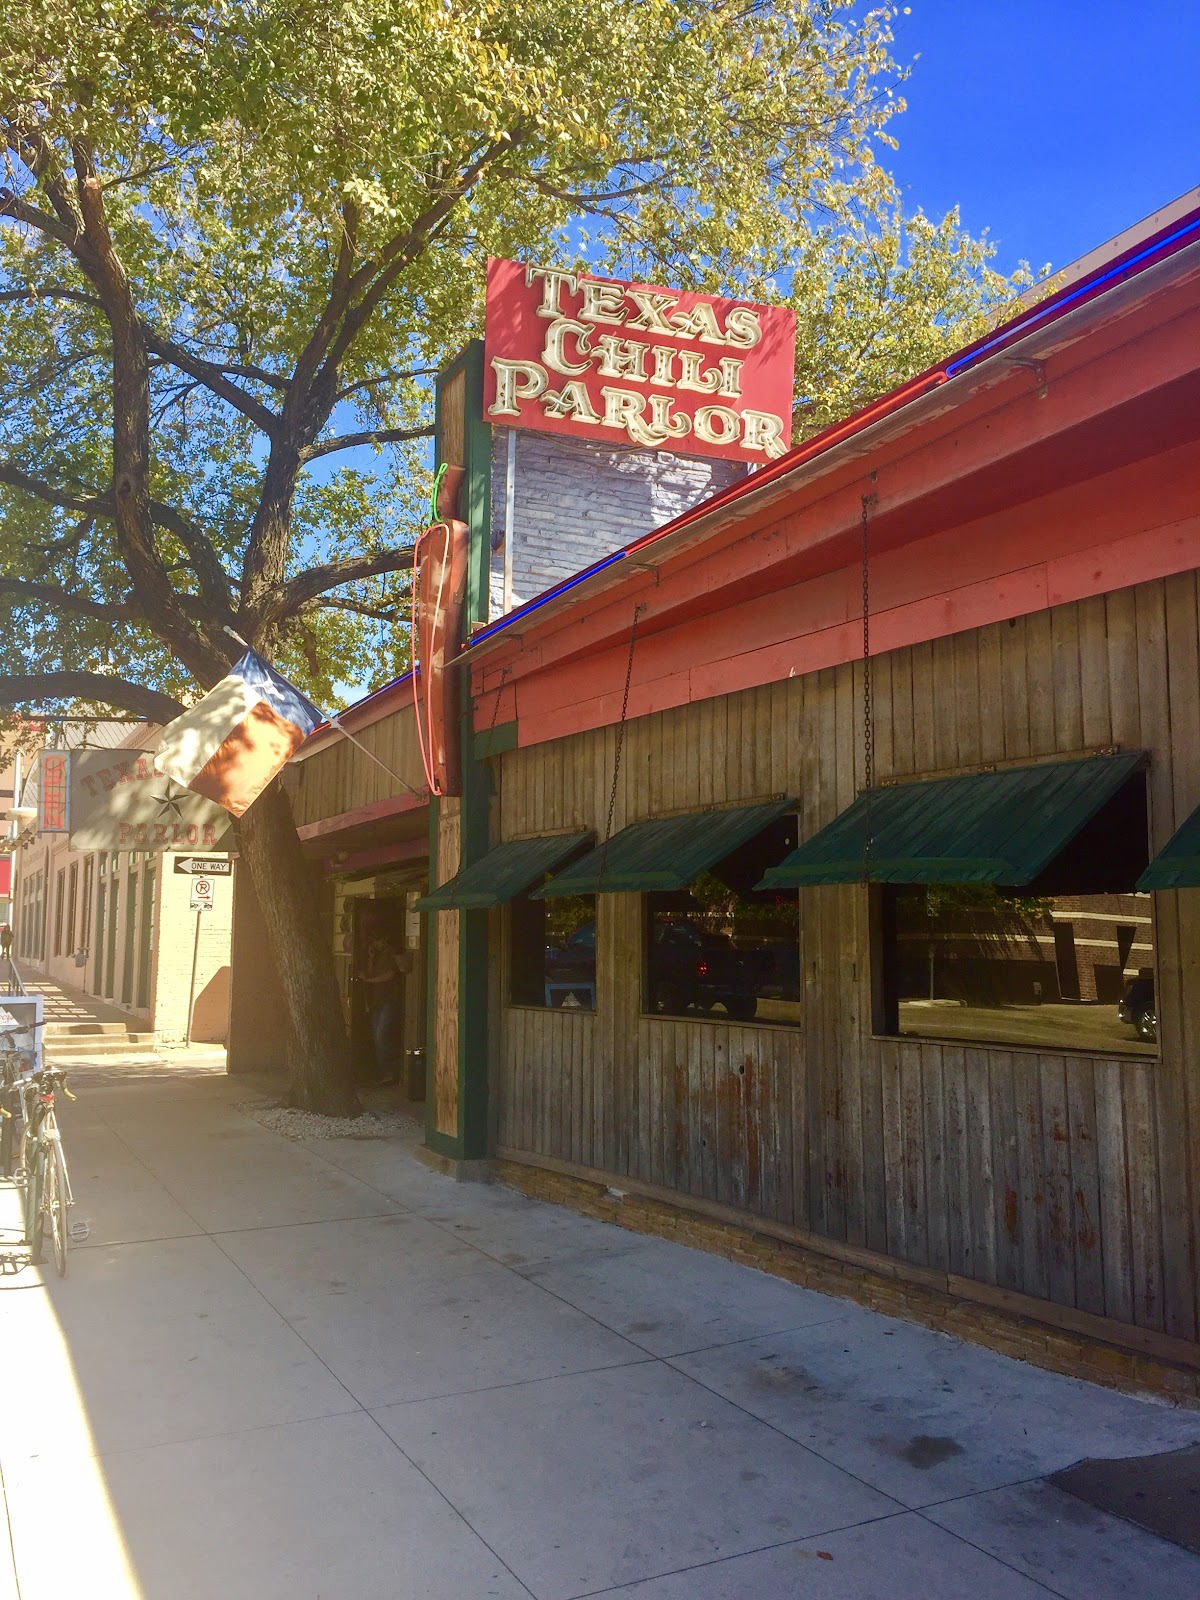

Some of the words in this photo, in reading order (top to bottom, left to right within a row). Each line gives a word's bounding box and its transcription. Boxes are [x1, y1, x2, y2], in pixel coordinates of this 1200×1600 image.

[525, 261, 763, 350] TEXAS
[541, 318, 745, 398] CHILI
[487, 356, 790, 460] PARLOR
[44, 756, 64, 829] OPEN
[118, 822, 217, 846] PARLOR
[191, 862, 207, 871] ONE
[210, 863, 227, 871] WAY
